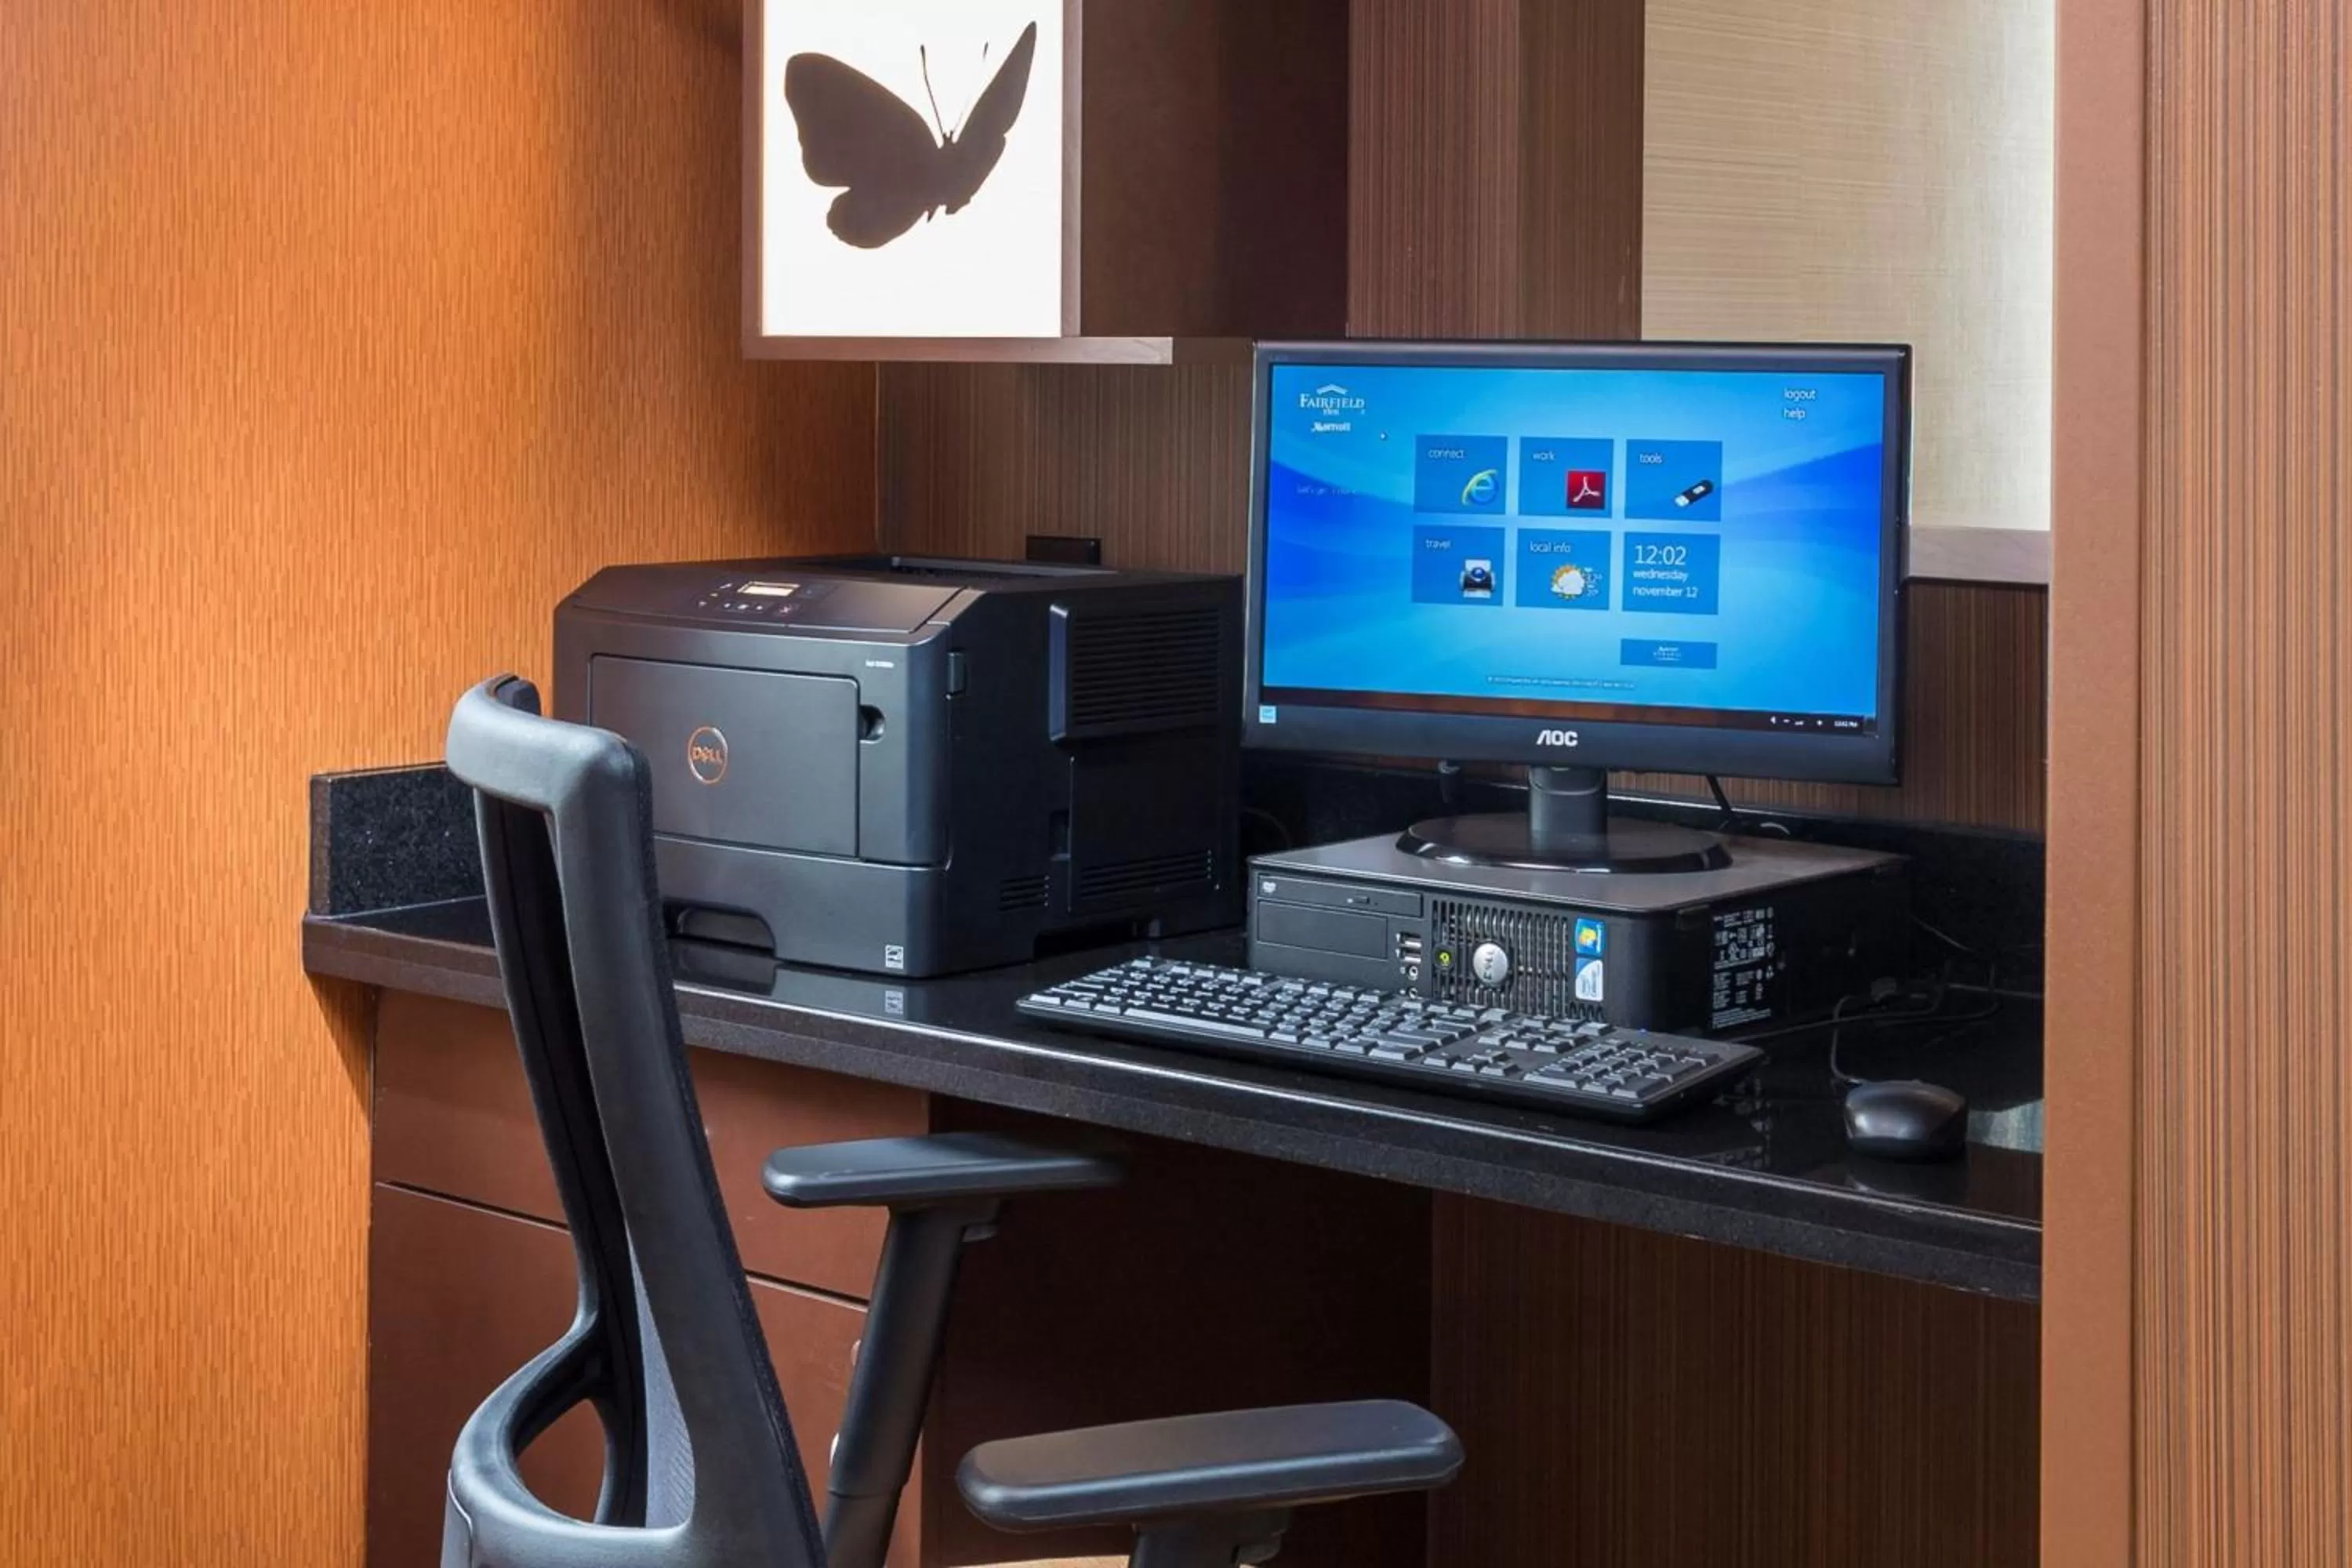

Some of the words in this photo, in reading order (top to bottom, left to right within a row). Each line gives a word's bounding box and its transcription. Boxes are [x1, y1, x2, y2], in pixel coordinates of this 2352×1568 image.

[1300, 393, 1366, 408] FAIRFIELD
[1784, 387, 1817, 402] logout
[1784, 408, 1806, 420] help
[1428, 448, 1465, 459] connect
[1533, 451, 1555, 461] work
[1639, 453, 1663, 464] tools
[1425, 539, 1451, 549] travel
[1530, 541, 1552, 553] local
[1553, 542, 1571, 553] info
[1634, 545, 1686, 565] 12:02
[1633, 569, 1688, 582] wednesday
[1633, 586, 1682, 597] november
[1686, 586, 1697, 597] 12
[1537, 730, 1578, 746] AOC
[692, 746, 722, 764] DELL
